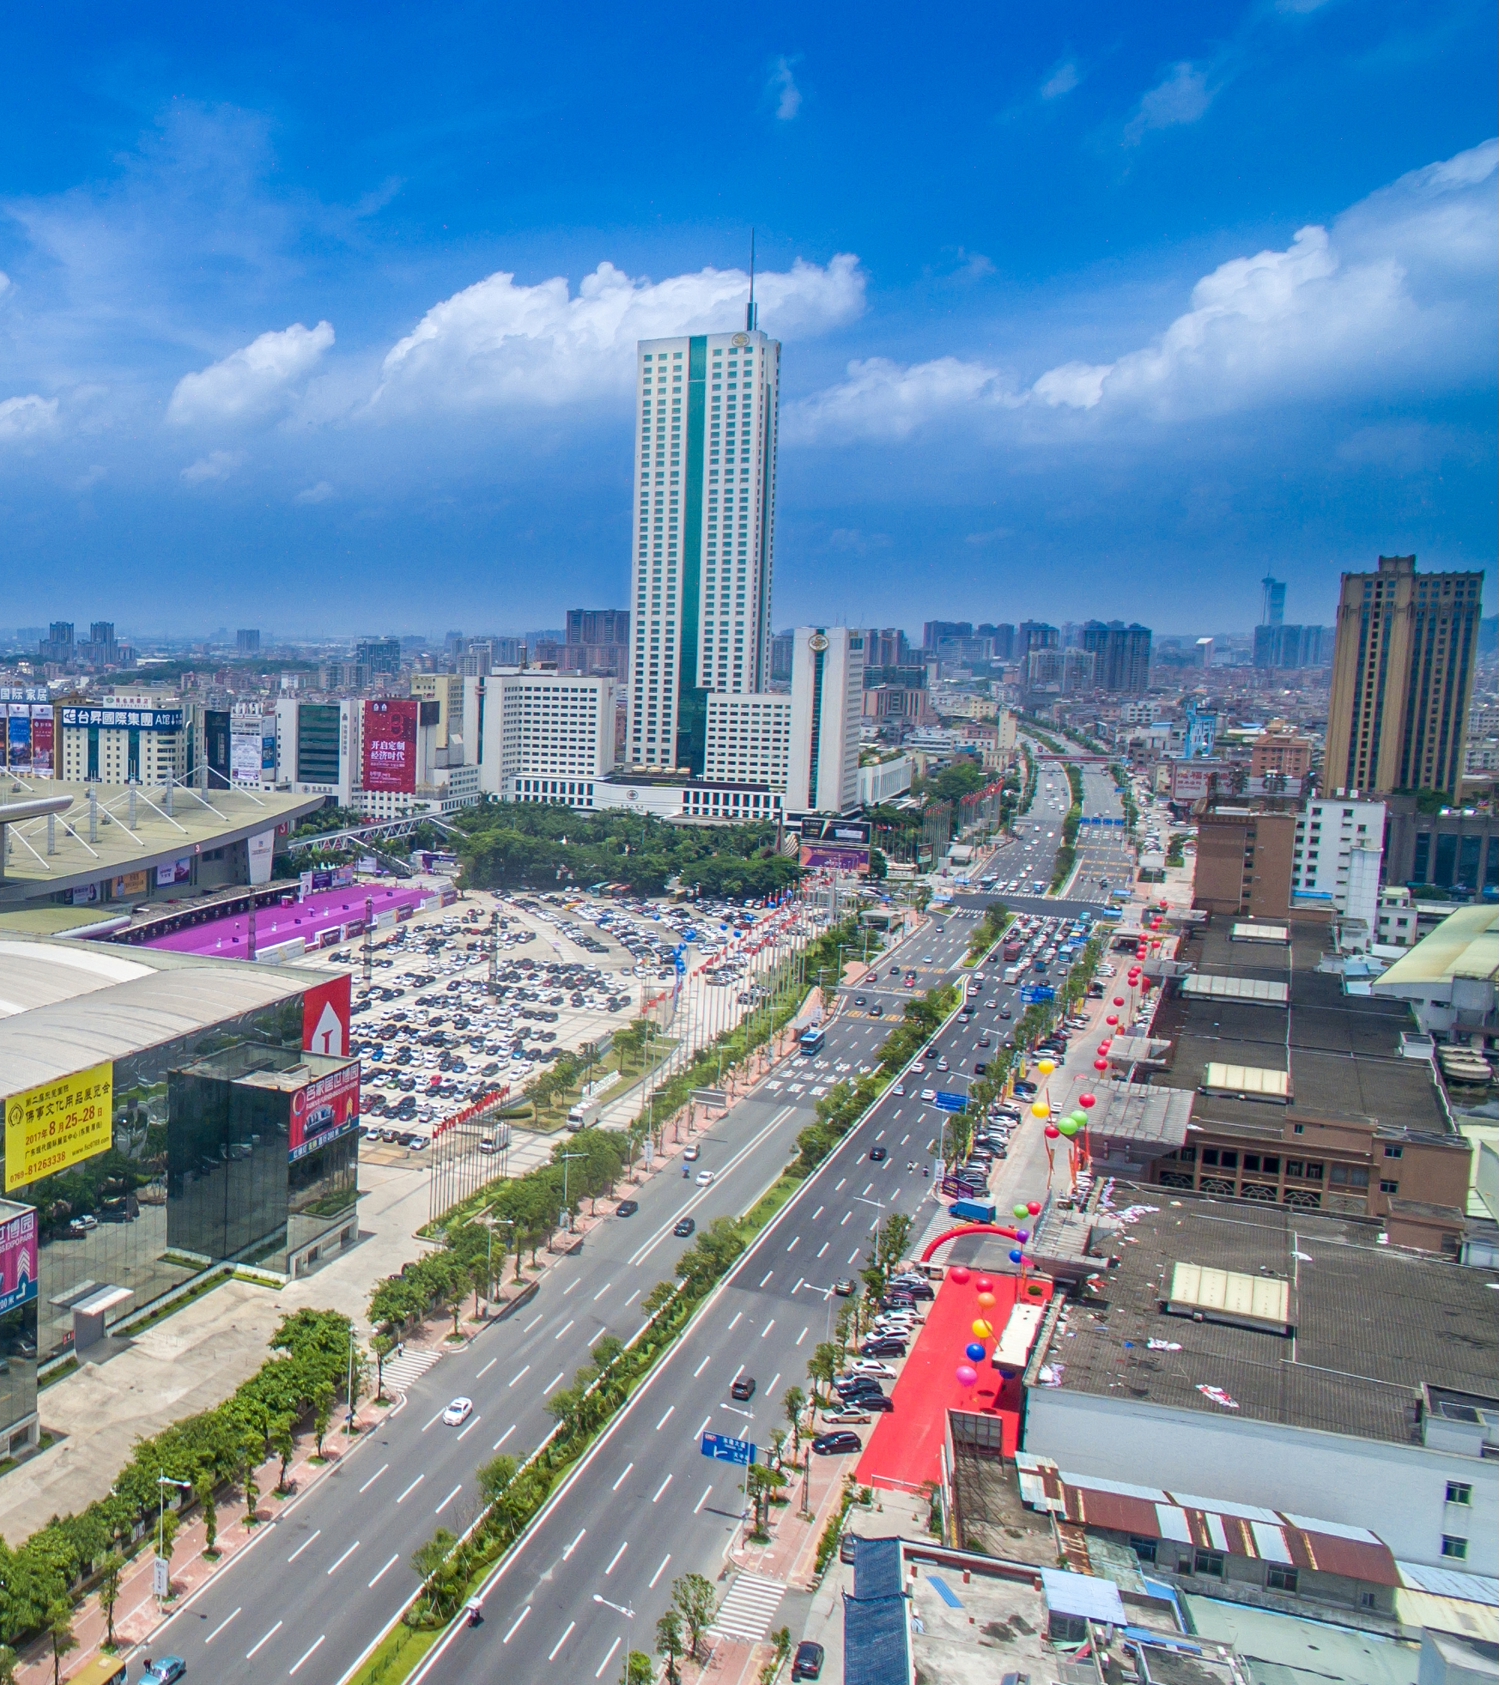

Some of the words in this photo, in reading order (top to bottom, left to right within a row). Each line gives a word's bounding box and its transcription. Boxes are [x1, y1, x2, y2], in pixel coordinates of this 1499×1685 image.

[77, 709, 154, 727] 台昇國際集團
[371, 740, 406, 751] 开启定制
[370, 750, 405, 761] 经济时代
[195, 844, 200, 853] 3
[9, 1151, 66, 1183] 0769-81263338
